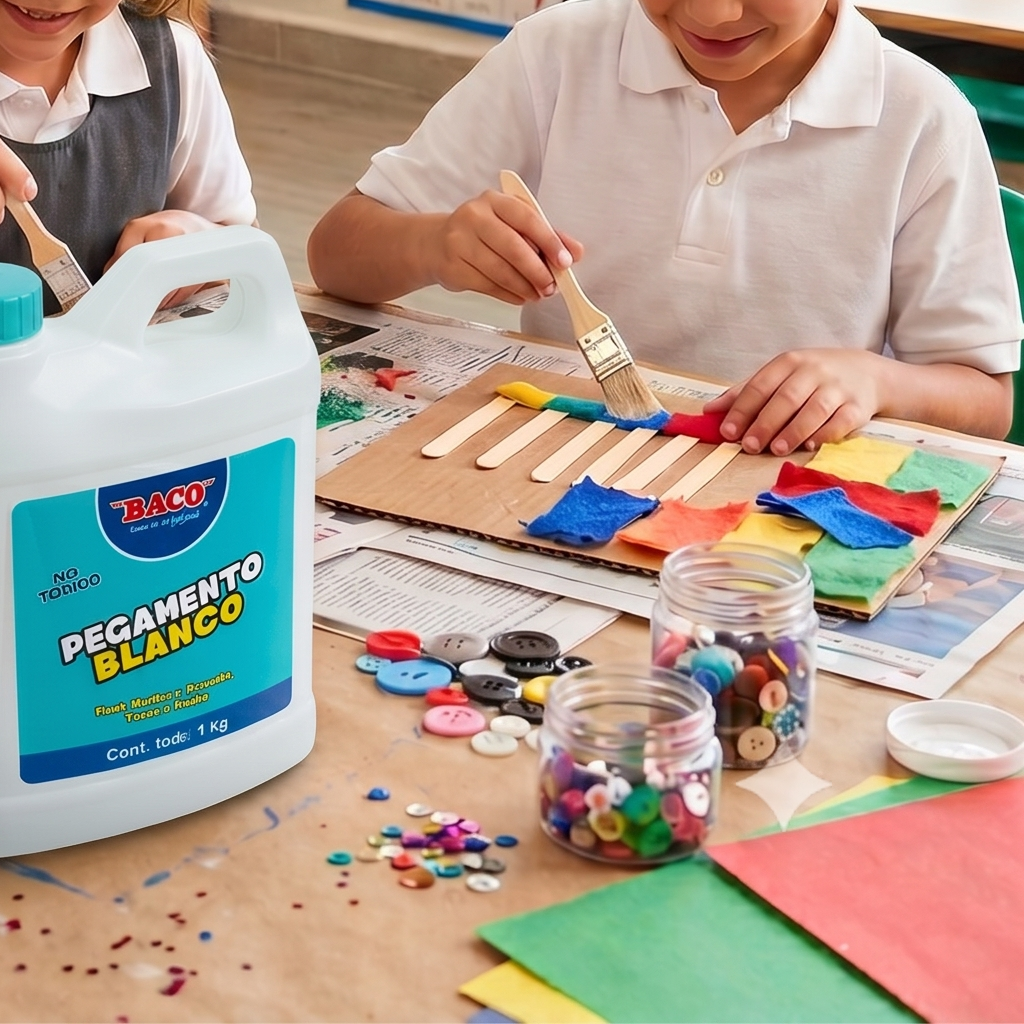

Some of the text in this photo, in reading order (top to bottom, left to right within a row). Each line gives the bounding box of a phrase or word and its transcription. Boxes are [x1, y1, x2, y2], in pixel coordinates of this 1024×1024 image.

[121, 481, 206, 523] BACO
[59, 552, 264, 665] PEGAMENTO
[92, 592, 245, 683] BLANCO
[106, 741, 150, 761] Cont.
[197, 723, 205, 736] 1
